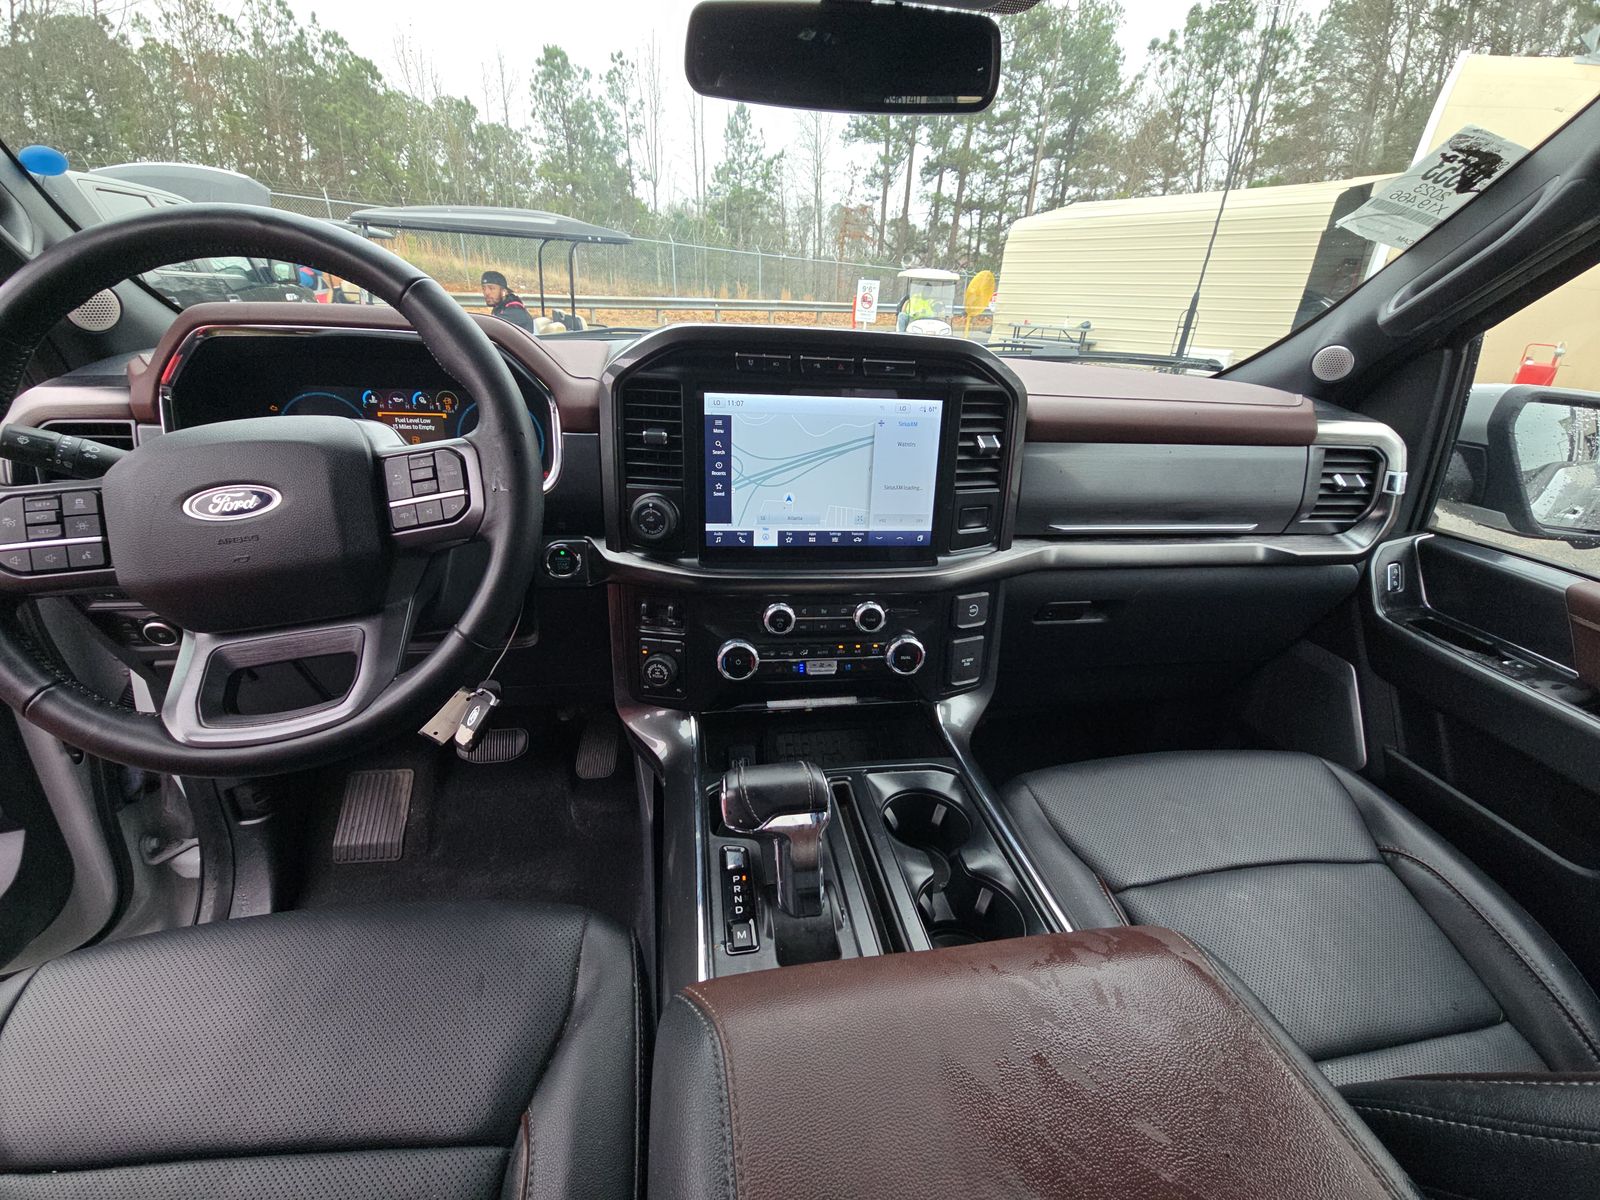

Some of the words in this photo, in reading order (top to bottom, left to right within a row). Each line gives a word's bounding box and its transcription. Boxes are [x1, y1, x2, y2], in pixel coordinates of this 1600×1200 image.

[208, 491, 259, 514] Ford
[732, 875, 740, 883] P
[733, 885, 741, 893] R
[734, 895, 743, 903] N
[735, 906, 744, 914] D
[736, 930, 747, 939] M
